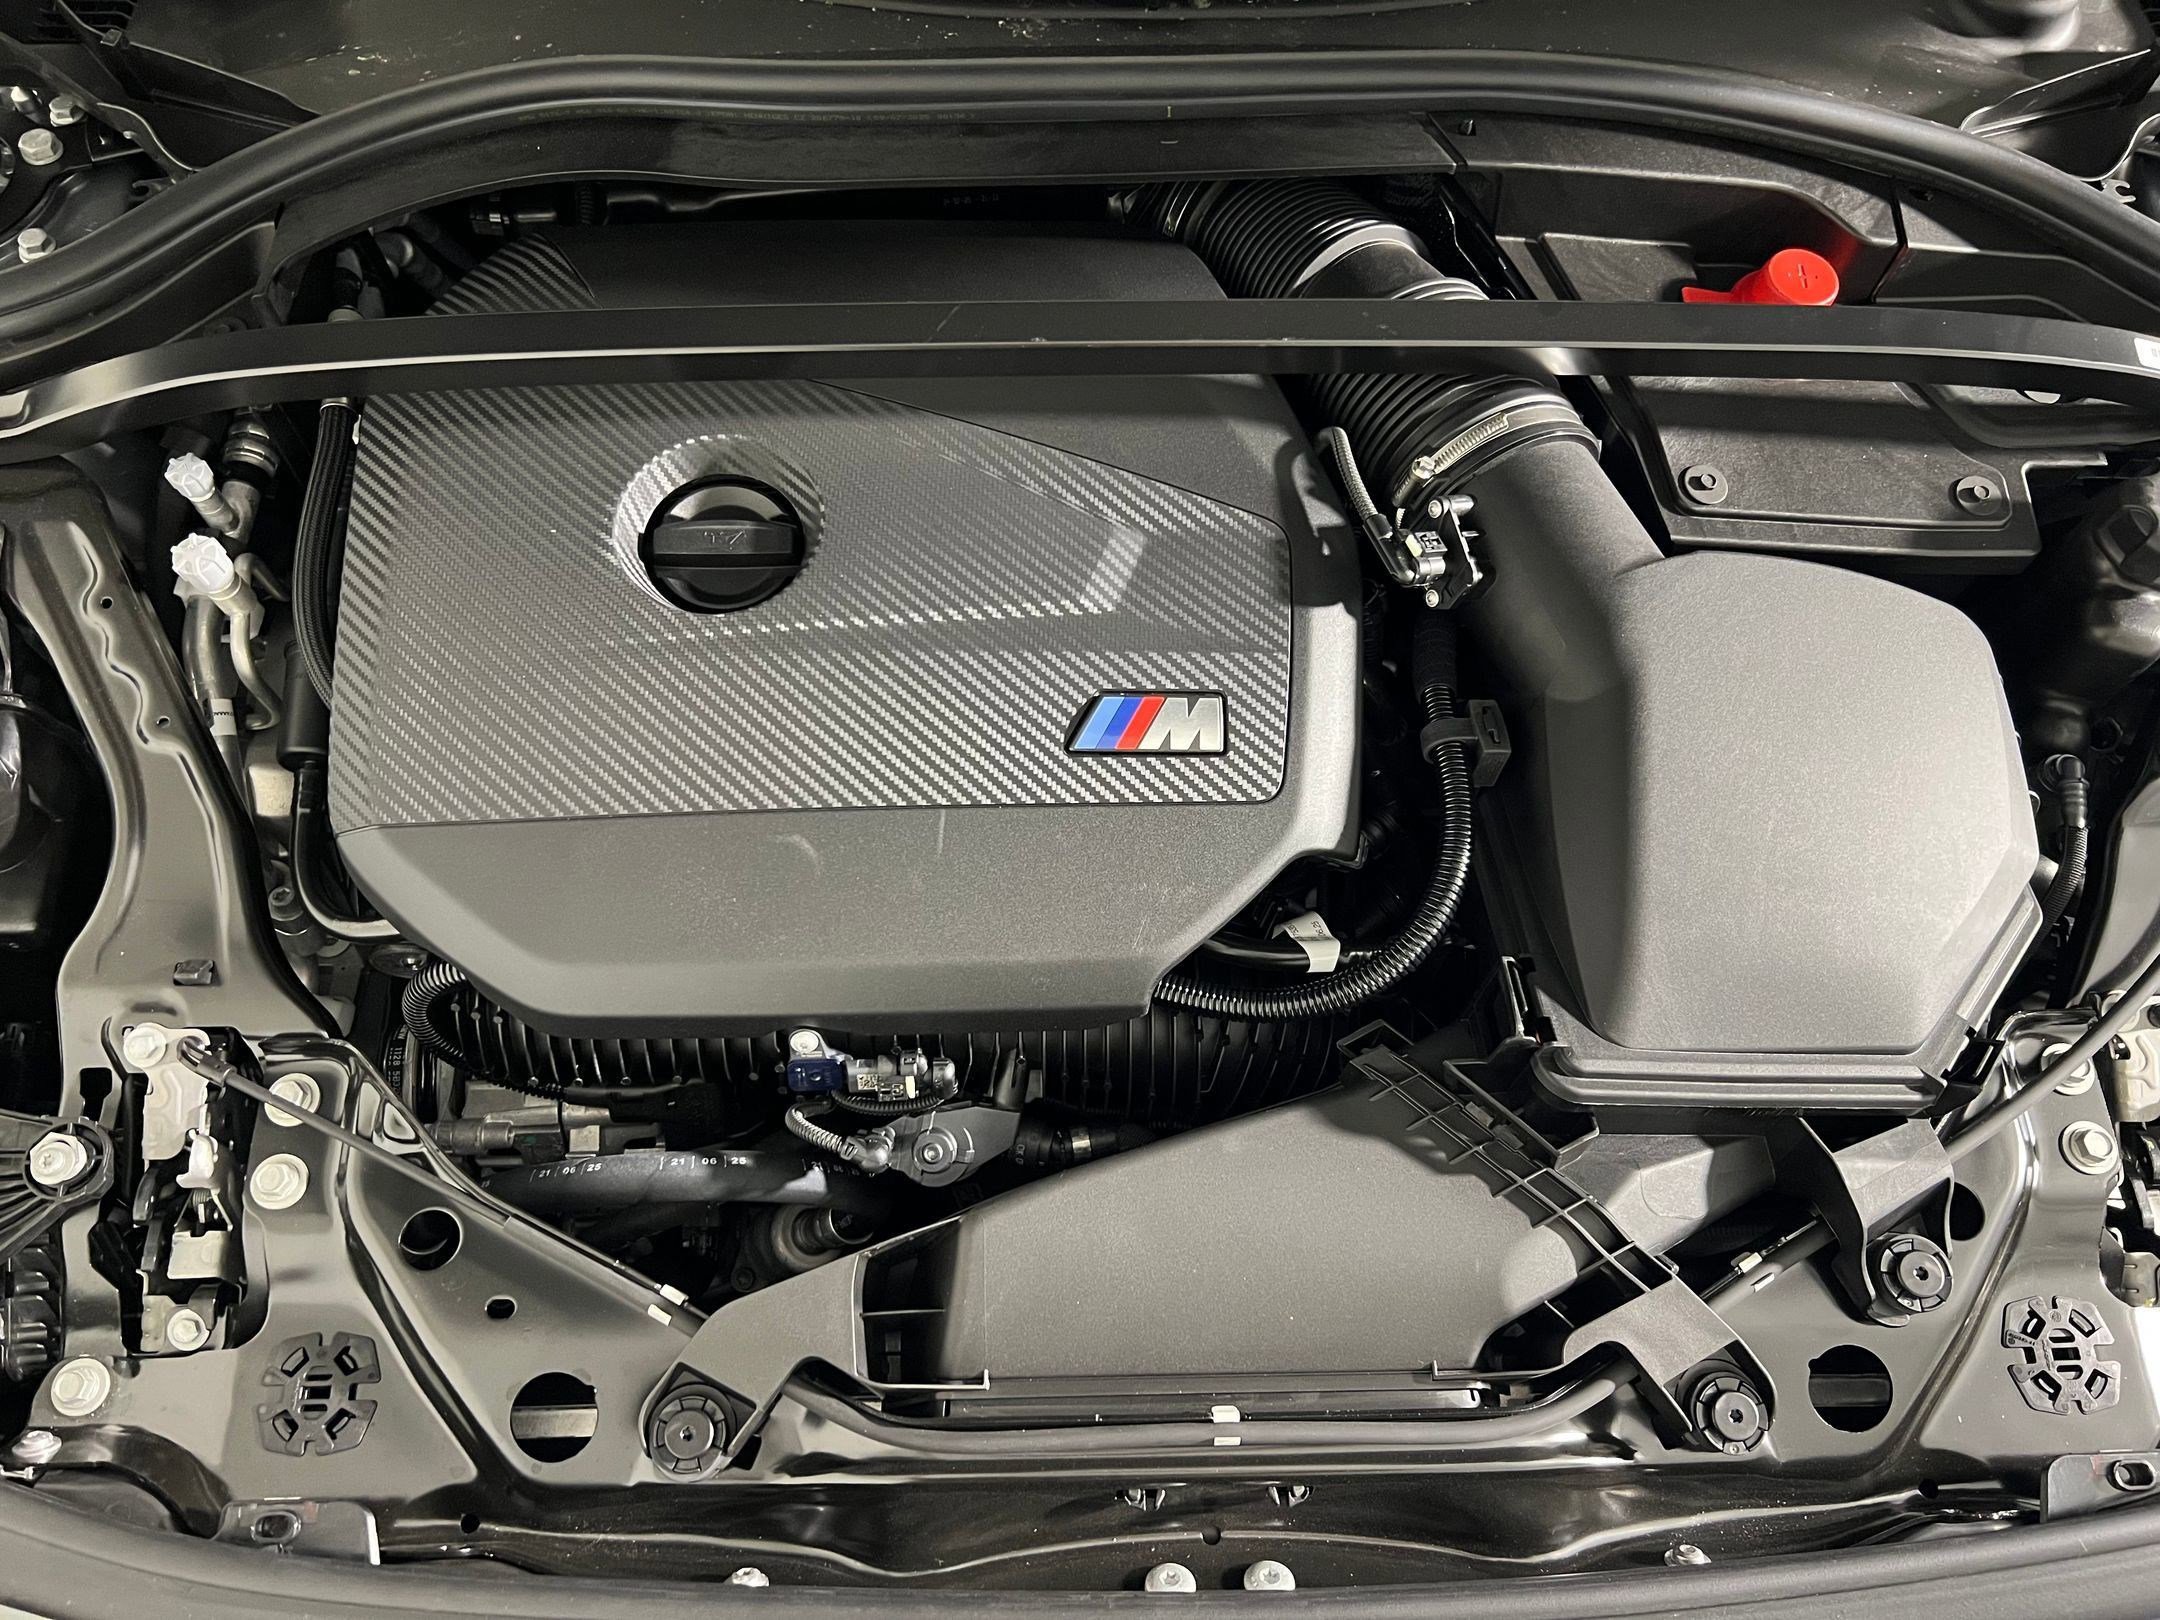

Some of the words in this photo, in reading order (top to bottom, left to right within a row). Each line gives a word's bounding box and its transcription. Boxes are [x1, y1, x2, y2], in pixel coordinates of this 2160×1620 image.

[1138, 696, 1224, 752] M
[392, 1047, 402, 1066] 1128
[670, 1158, 685, 1166] 21
[701, 1157, 717, 1165] 06
[730, 1156, 747, 1165] 25
[538, 1169, 551, 1178] 21
[562, 1166, 577, 1175] 06
[586, 1162, 602, 1172] 25
